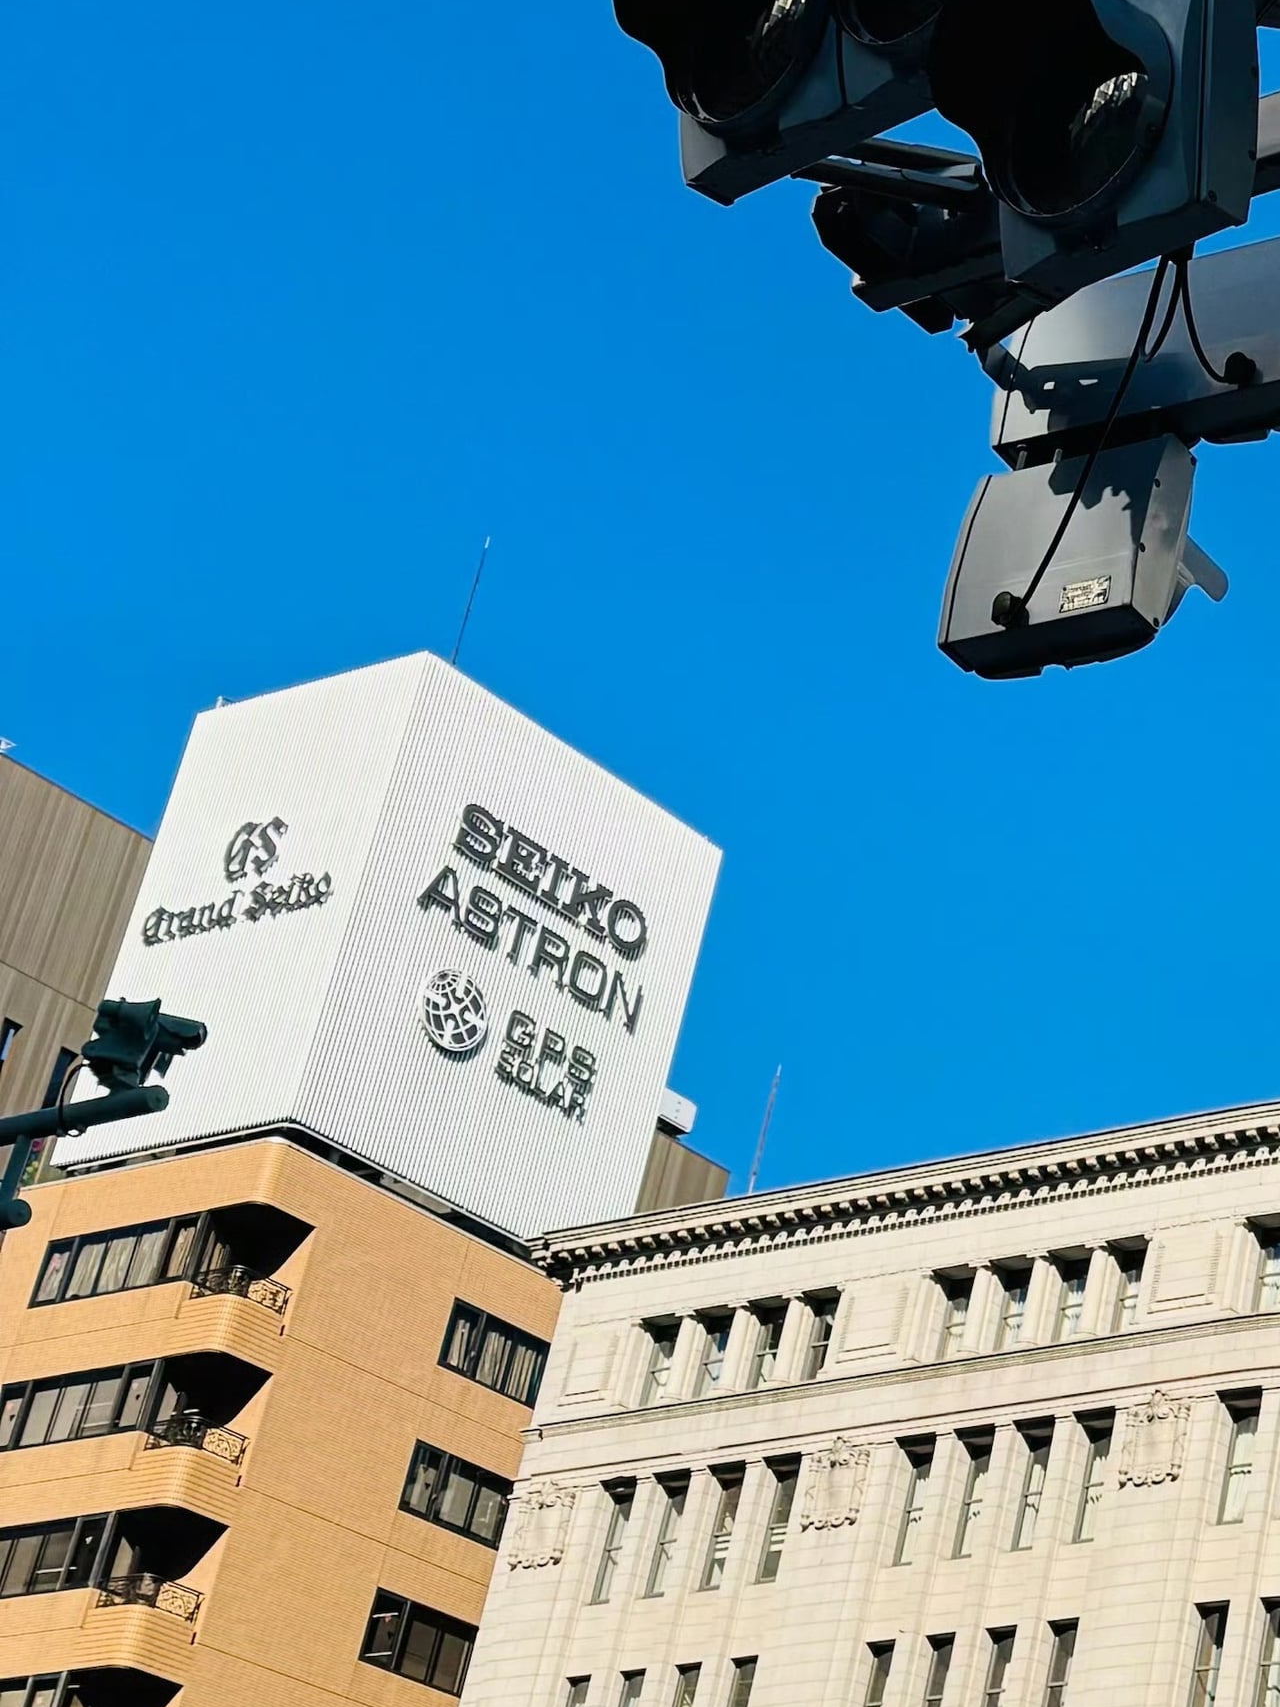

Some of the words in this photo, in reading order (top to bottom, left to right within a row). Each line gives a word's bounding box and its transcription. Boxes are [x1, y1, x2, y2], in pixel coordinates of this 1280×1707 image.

[142, 889, 242, 945] Grand
[244, 871, 333, 922] Seiko
[452, 803, 648, 955] SEIKO
[417, 866, 645, 1036] ASTRON
[496, 1046, 588, 1124] SOLAR
[502, 1009, 598, 1088] GPS
